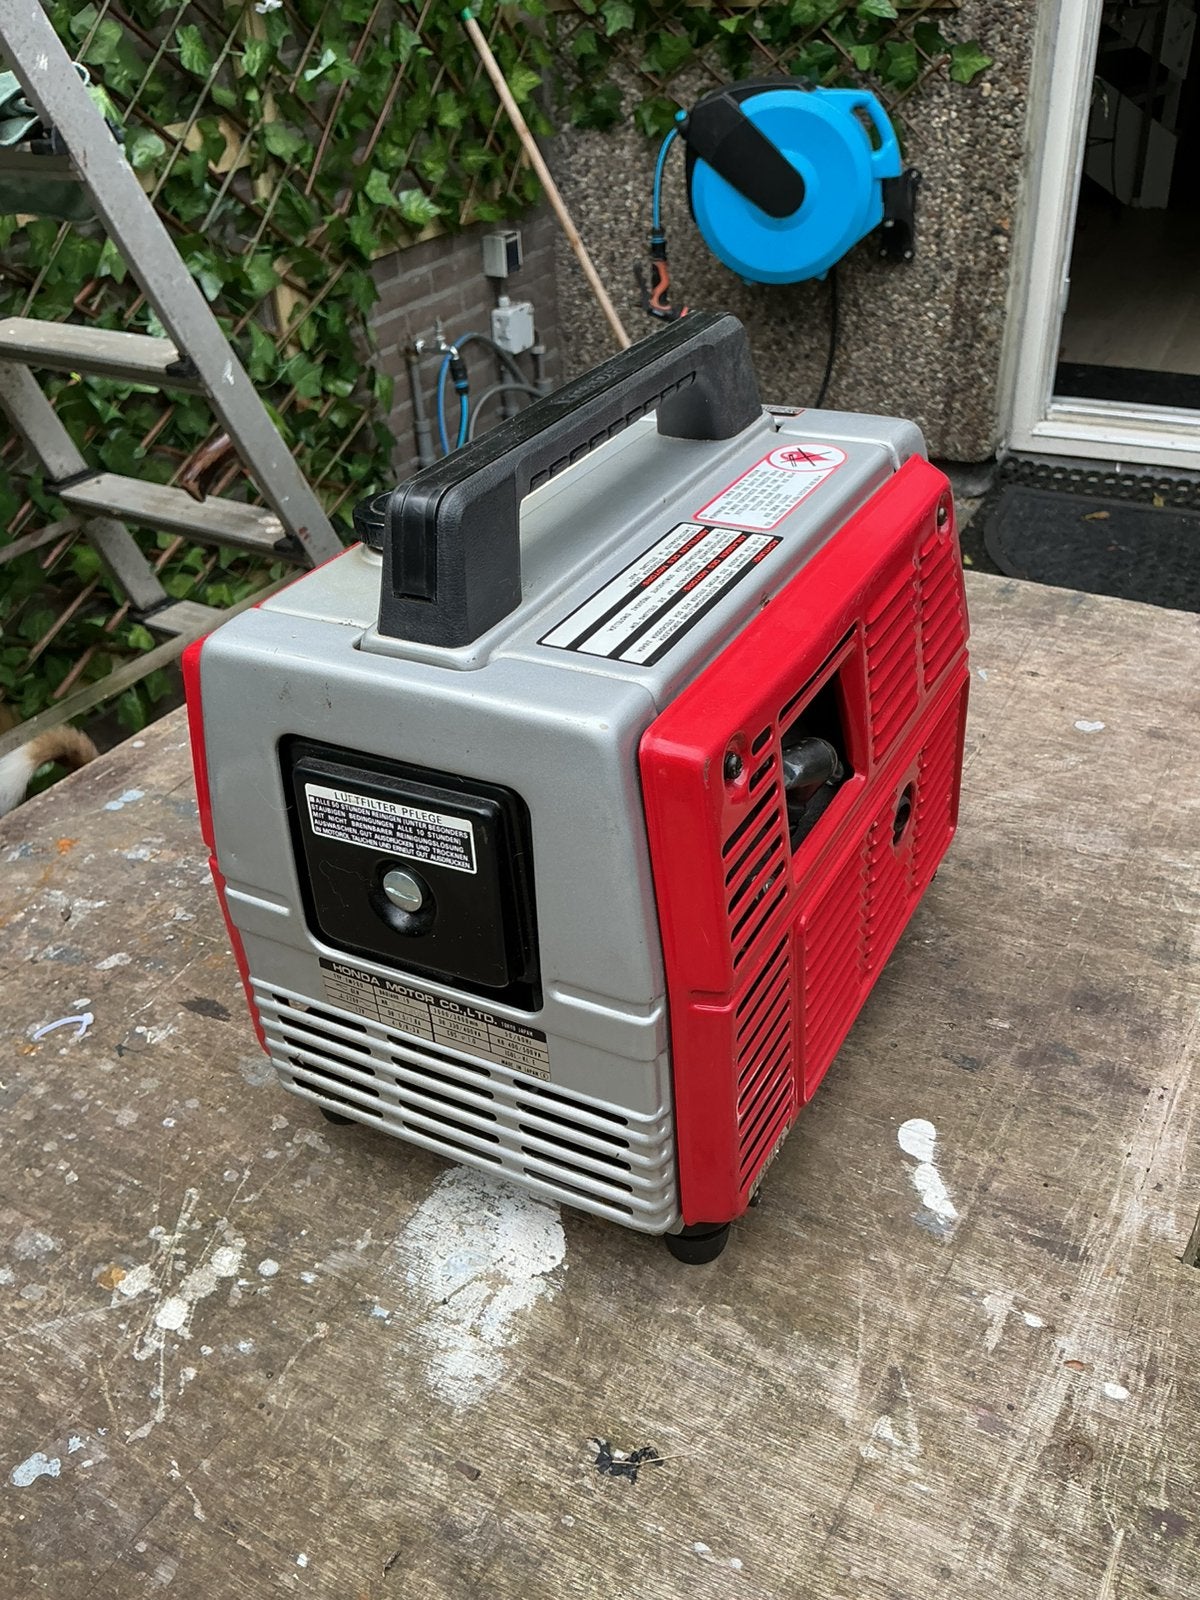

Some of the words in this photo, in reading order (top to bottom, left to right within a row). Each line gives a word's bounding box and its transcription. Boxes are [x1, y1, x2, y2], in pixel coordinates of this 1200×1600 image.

[311, 810, 325, 819] MIT
[327, 814, 347, 824] NICHT
[350, 820, 393, 836] BRENNBARER
[315, 797, 330, 806] ALLE
[340, 803, 370, 815] STUNDEN
[371, 810, 401, 823] REINIGEN
[427, 823, 468, 839] BESONDERS
[348, 812, 394, 828] BEDINGUNGEN
[396, 823, 412, 833] ALLE
[401, 807, 442, 824] PFLEGE
[415, 843, 430, 852] UND
[332, 962, 380, 986] HONDA
[385, 980, 434, 1004] MOTOR
[439, 998, 497, 1026] CO.,LTD.
